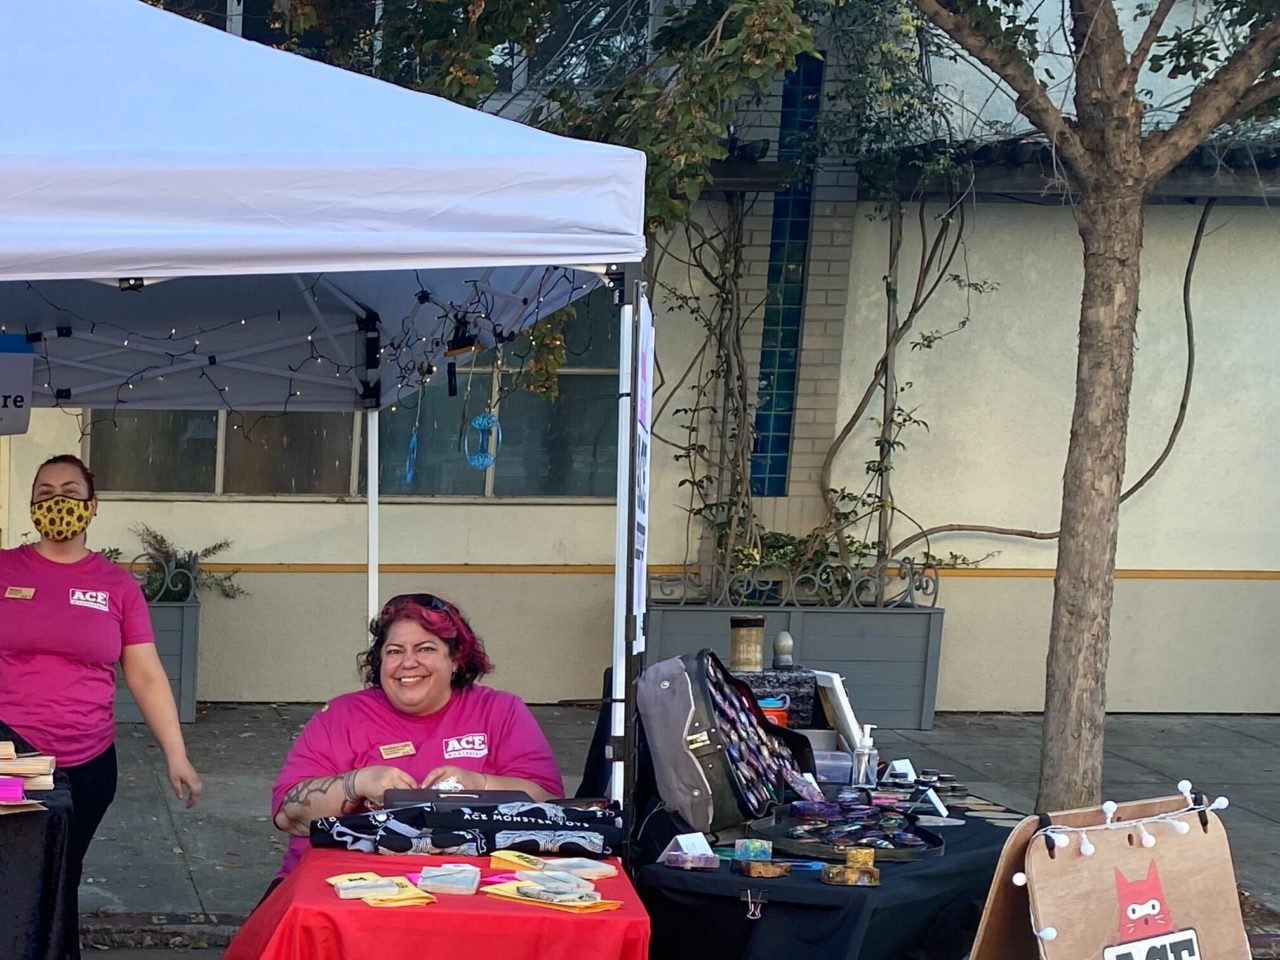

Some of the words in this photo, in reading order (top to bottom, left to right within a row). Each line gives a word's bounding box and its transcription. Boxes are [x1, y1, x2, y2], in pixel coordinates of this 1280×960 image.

[72, 591, 107, 605] ACE
[447, 735, 485, 752] ACE
[463, 813, 488, 821] ACE
[493, 814, 553, 826] MONSTER
